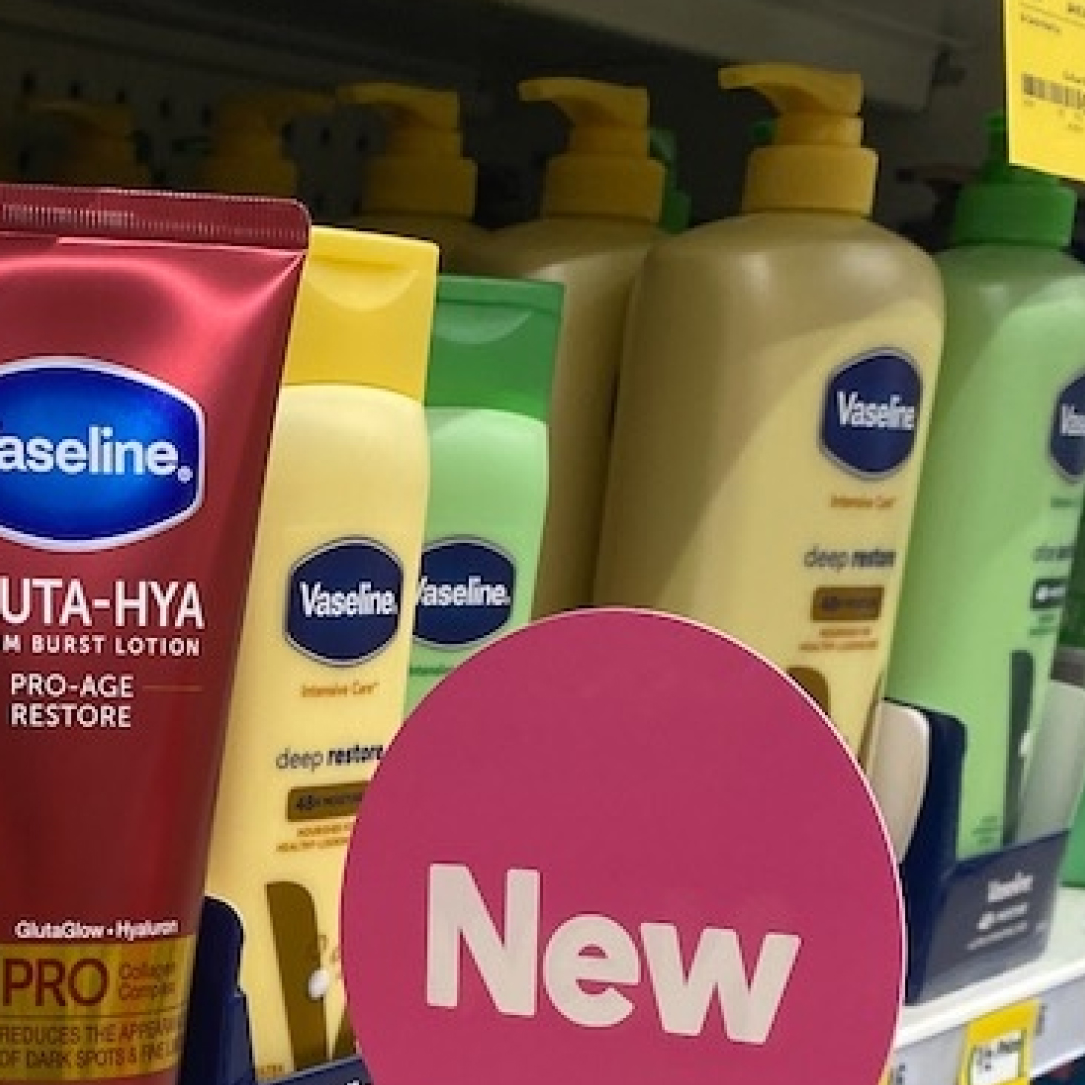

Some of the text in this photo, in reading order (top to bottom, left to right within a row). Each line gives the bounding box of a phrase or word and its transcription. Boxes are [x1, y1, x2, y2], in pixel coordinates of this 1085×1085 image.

[300, 581, 399, 617] Vaseline
[31, 634, 105, 654] BURST
[115, 637, 199, 656] LOTION
[11, 672, 134, 698] PRO-AGE
[11, 704, 132, 728] RESTORE
[276, 746, 323, 771] deep
[14, 919, 105, 939] GlutaGlow
[427, 862, 802, 1045] New
[2, 957, 108, 1006] PRO
[0, 1025, 81, 1045] REDUCES
[86, 1024, 115, 1043] THE
[26, 1050, 72, 1070] DARK
[76, 1047, 126, 1069] SPOTS
